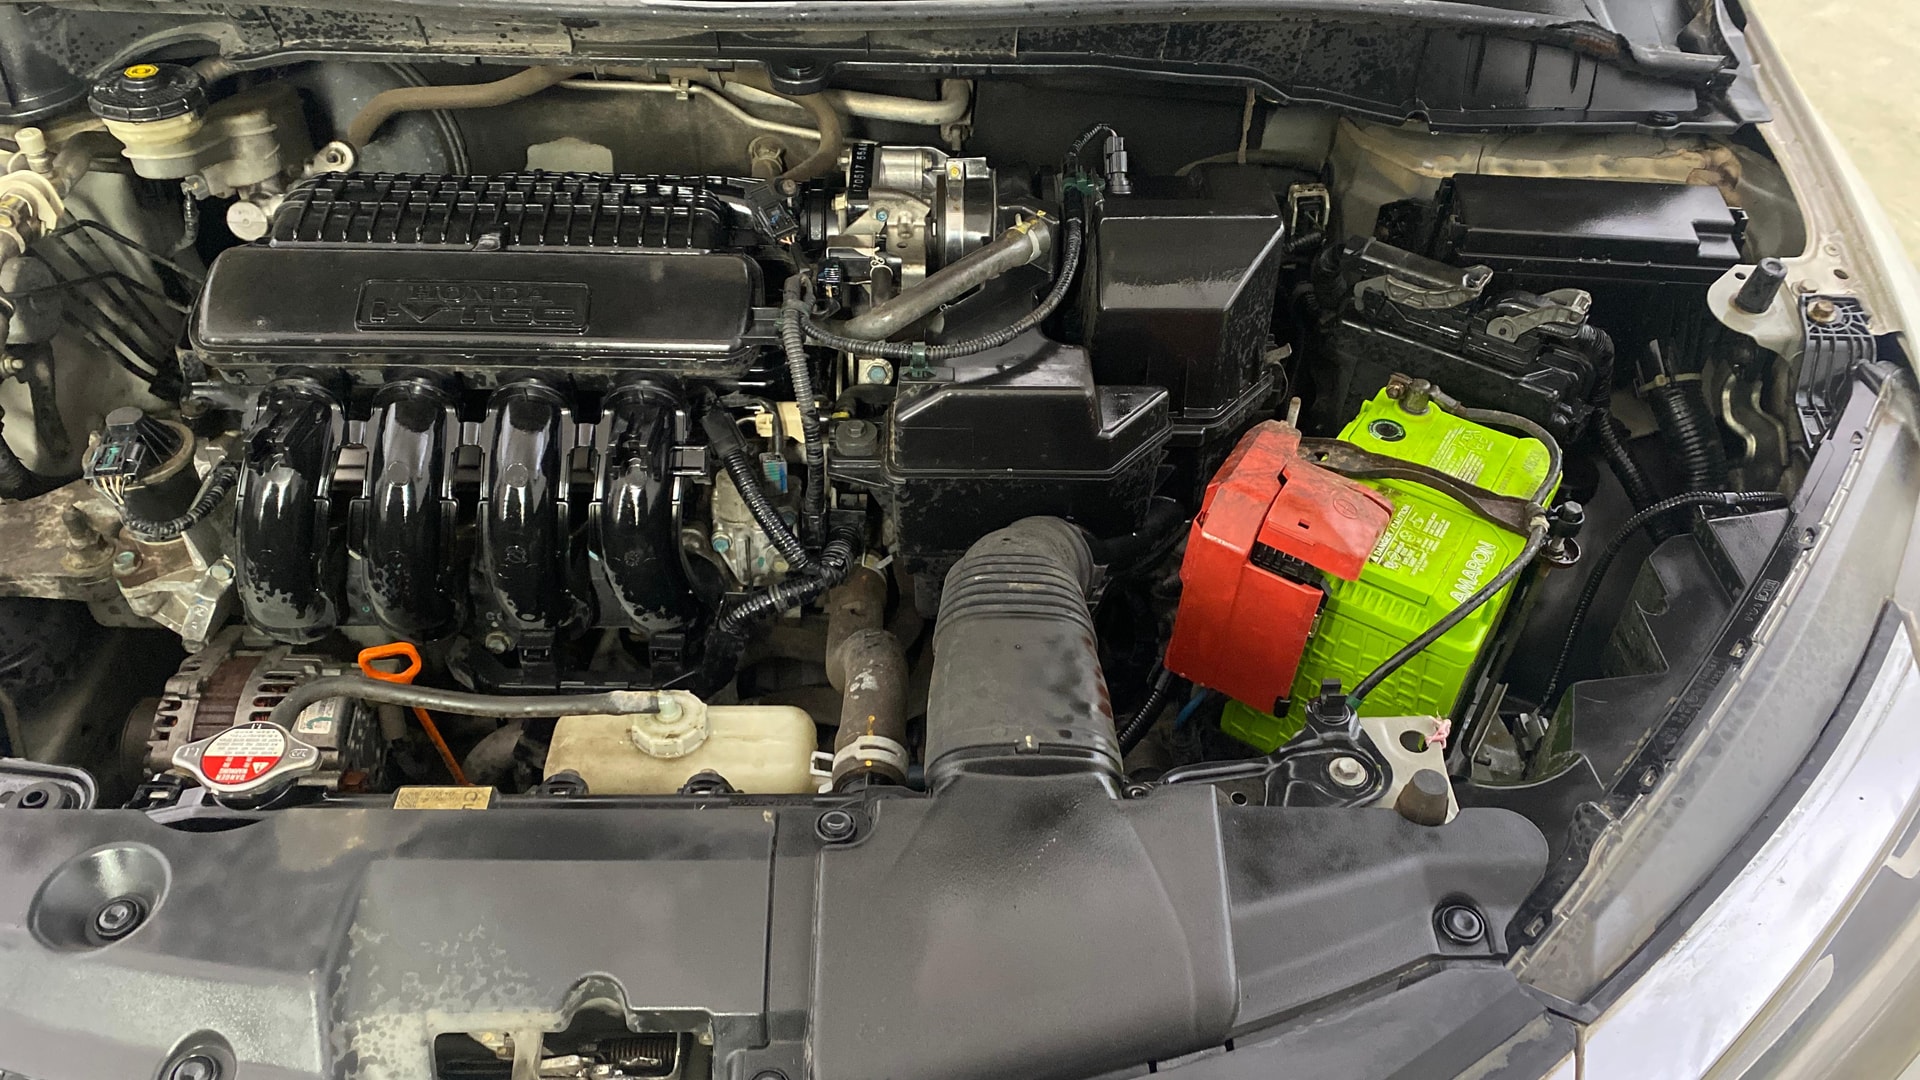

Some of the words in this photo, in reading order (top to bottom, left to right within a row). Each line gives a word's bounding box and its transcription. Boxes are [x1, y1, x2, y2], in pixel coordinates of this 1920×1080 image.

[407, 286, 553, 304] HONDA
[1374, 532, 1392, 557] DANGER
[1391, 504, 1411, 529] CAUTION
[1450, 540, 1498, 604] AMARON
